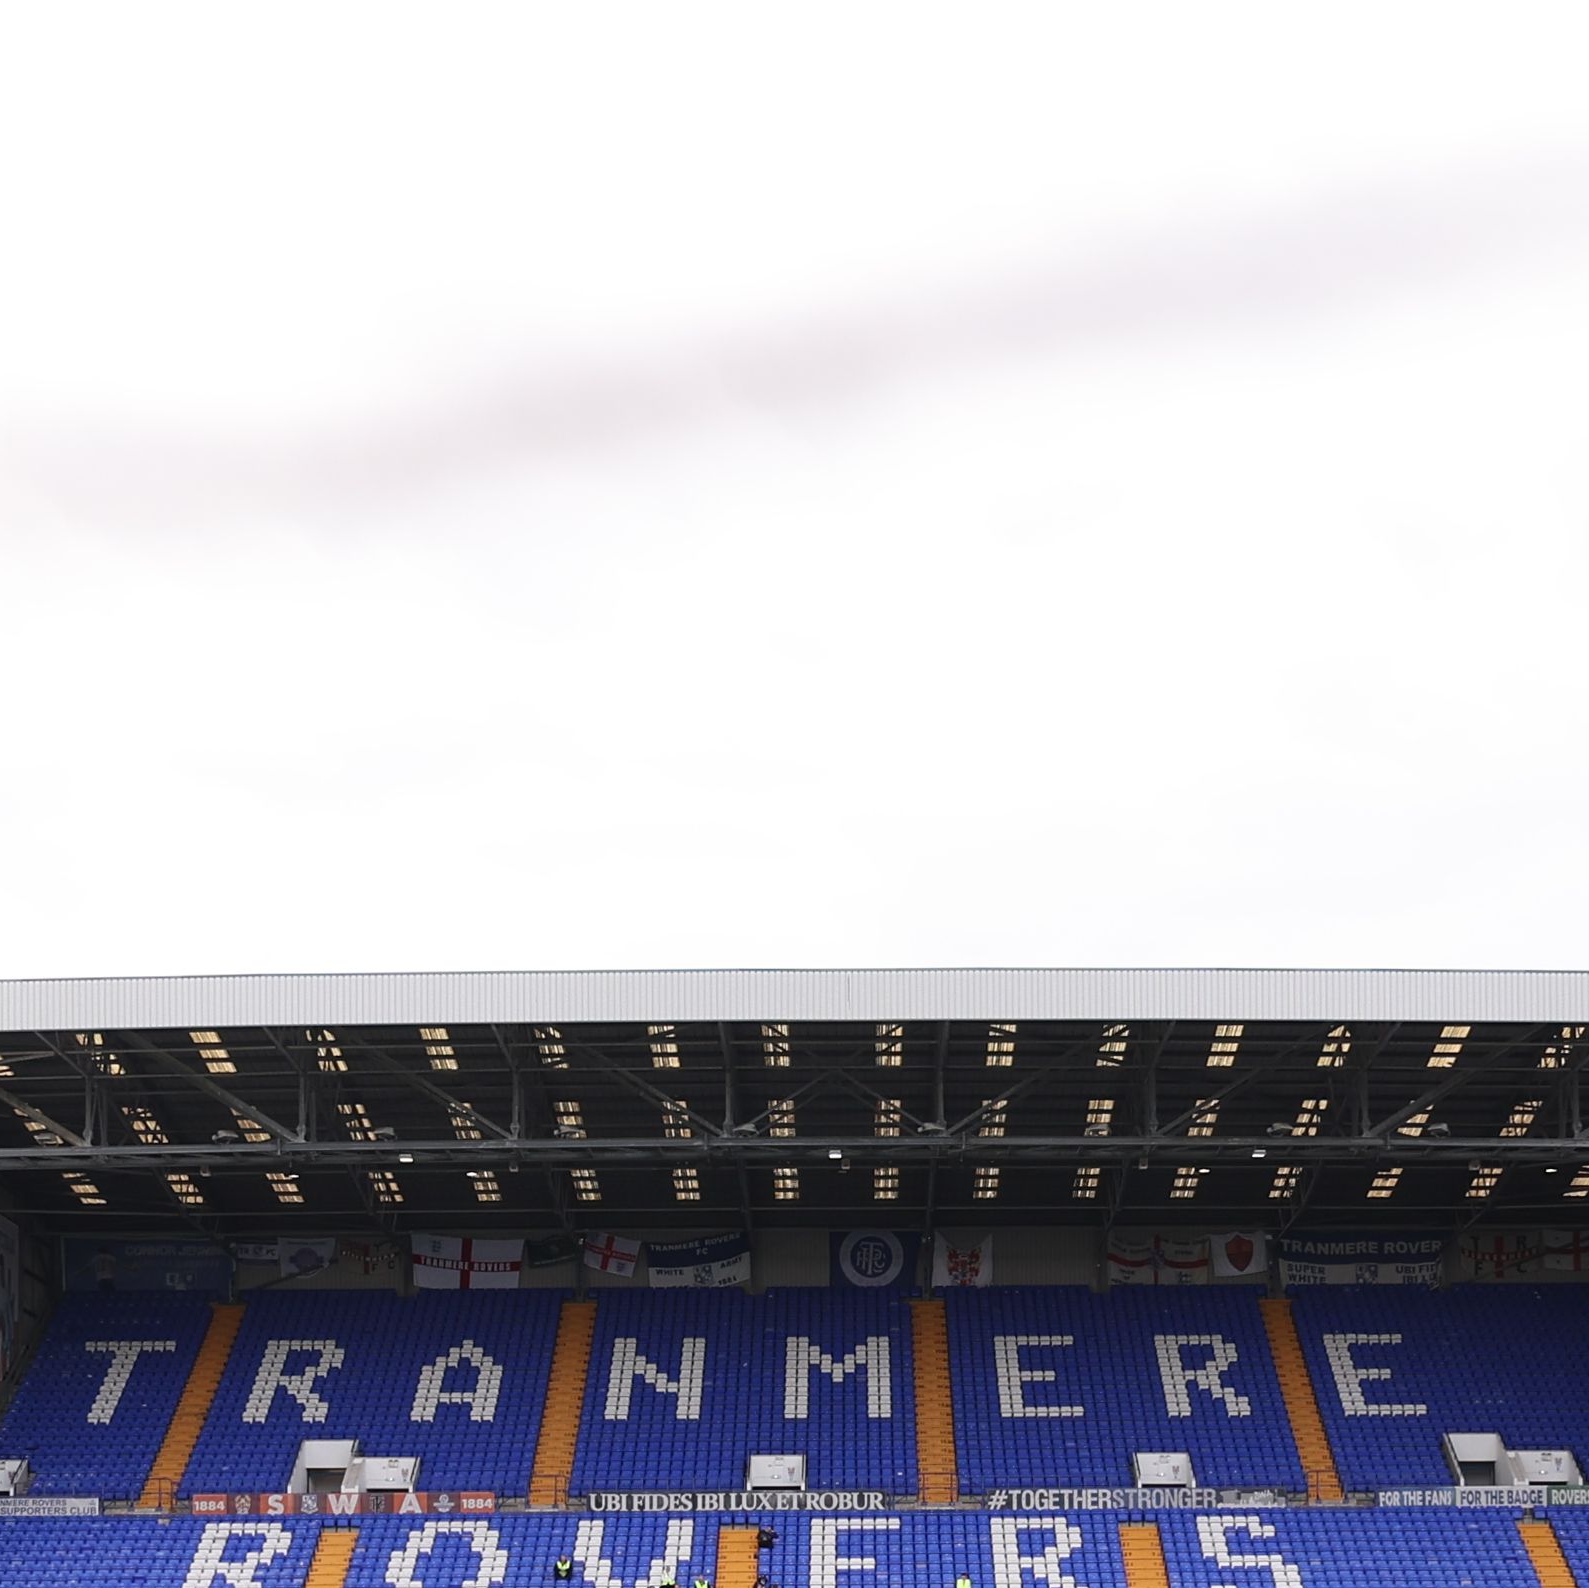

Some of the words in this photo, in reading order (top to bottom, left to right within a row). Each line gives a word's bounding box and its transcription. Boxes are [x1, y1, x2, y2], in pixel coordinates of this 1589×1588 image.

[1280, 1238, 1378, 1255] TRANMERE
[1384, 1240, 1442, 1254] ROVER
[421, 1258, 470, 1271] TRANMERE
[473, 1262, 511, 1272] ROVERS
[655, 1269, 684, 1277] WHITE
[1288, 1264, 1325, 1274] SUPER
[1288, 1274, 1326, 1283] WHITE
[85, 1333, 1428, 1424] TRANMERE
[32, 1499, 67, 1507] ROVERS
[194, 1500, 225, 1512] 1884
[268, 1495, 285, 1514] S
[328, 1495, 359, 1514] W
[399, 1495, 422, 1514] A
[462, 1498, 493, 1510] 1884
[589, 1492, 632, 1511] UBI
[633, 1492, 693, 1511] FIDES
[696, 1492, 729, 1511] IBI
[730, 1492, 775, 1511] LUX
[776, 1492, 805, 1511] ET
[806, 1492, 885, 1511] ROBUR
[988, 1489, 1216, 1510] #TOGETHERSTRONGER
[1379, 1491, 1401, 1507] FOR
[1402, 1490, 1422, 1506] THE
[1424, 1490, 1453, 1506] FANS
[1460, 1490, 1481, 1505] FOR
[1484, 1490, 1505, 1505] THE
[1507, 1489, 1543, 1505] BADGE
[4, 1507, 67, 1515] SUPPORTERS
[70, 1507, 96, 1515] CLUB
